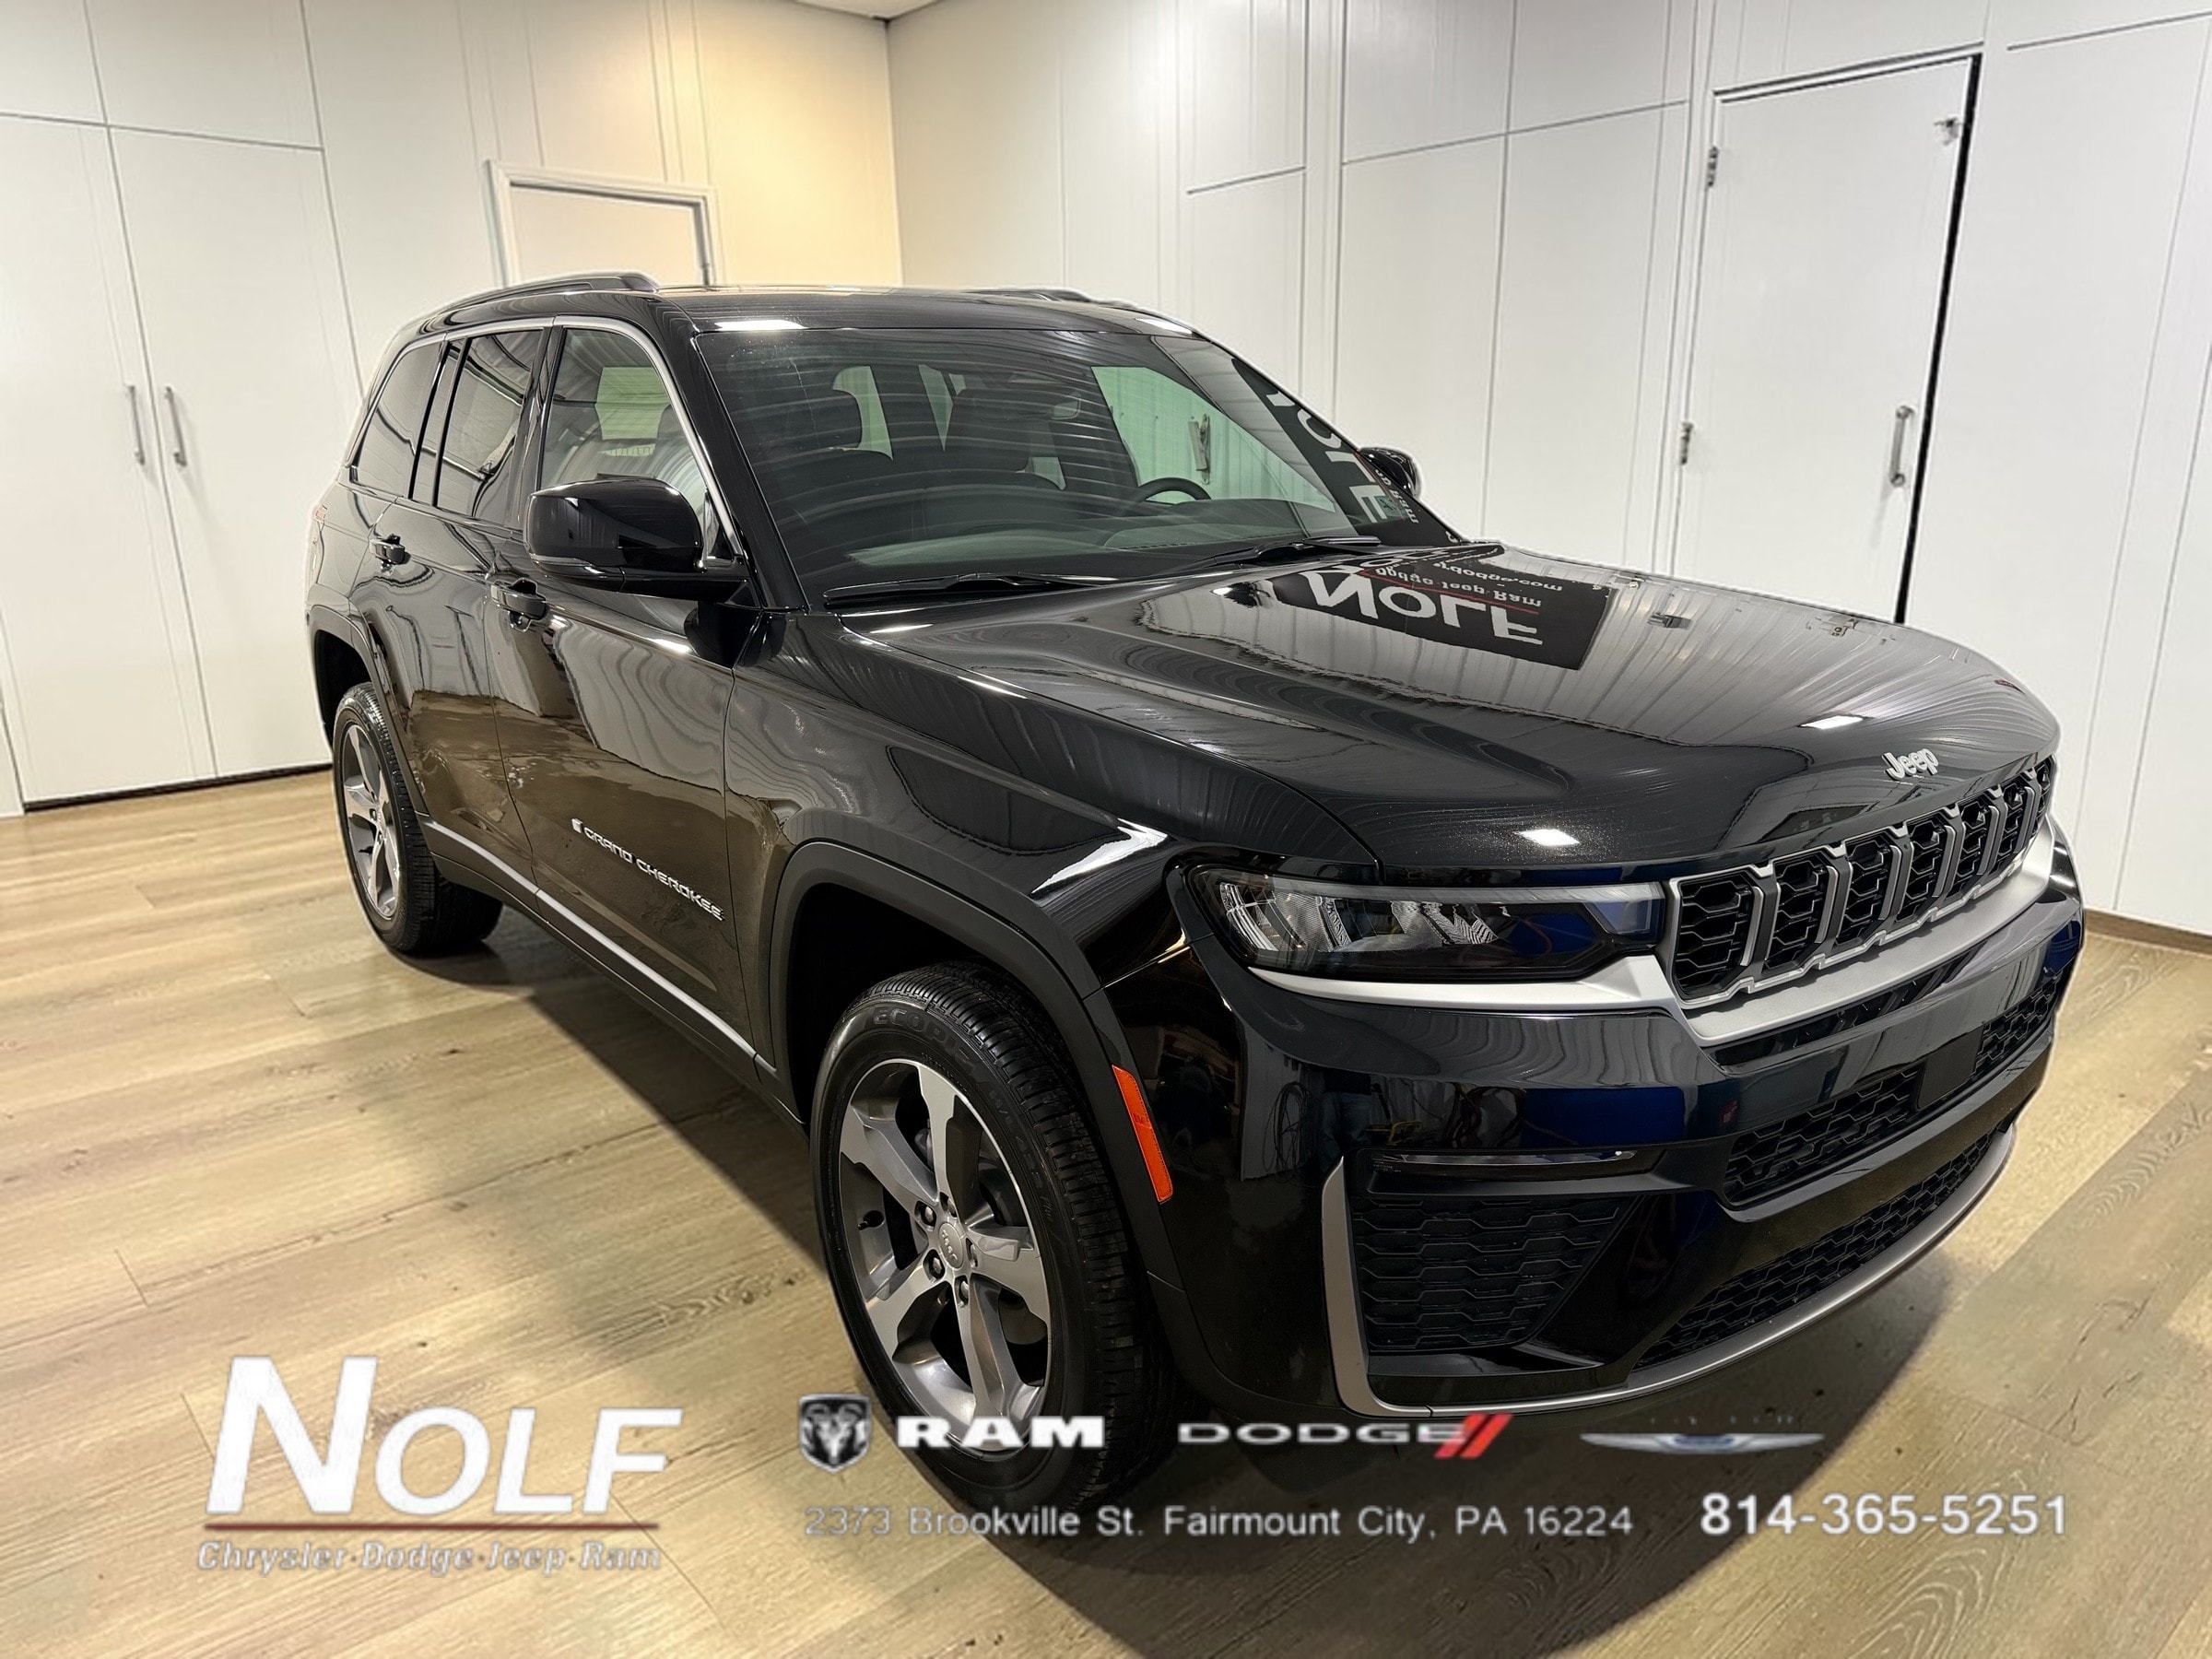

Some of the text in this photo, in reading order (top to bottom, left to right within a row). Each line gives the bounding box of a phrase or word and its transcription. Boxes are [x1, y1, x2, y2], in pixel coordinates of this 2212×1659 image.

[1881, 748, 1939, 781] Jeep
[583, 827, 724, 922] GRAND CHEROKEE
